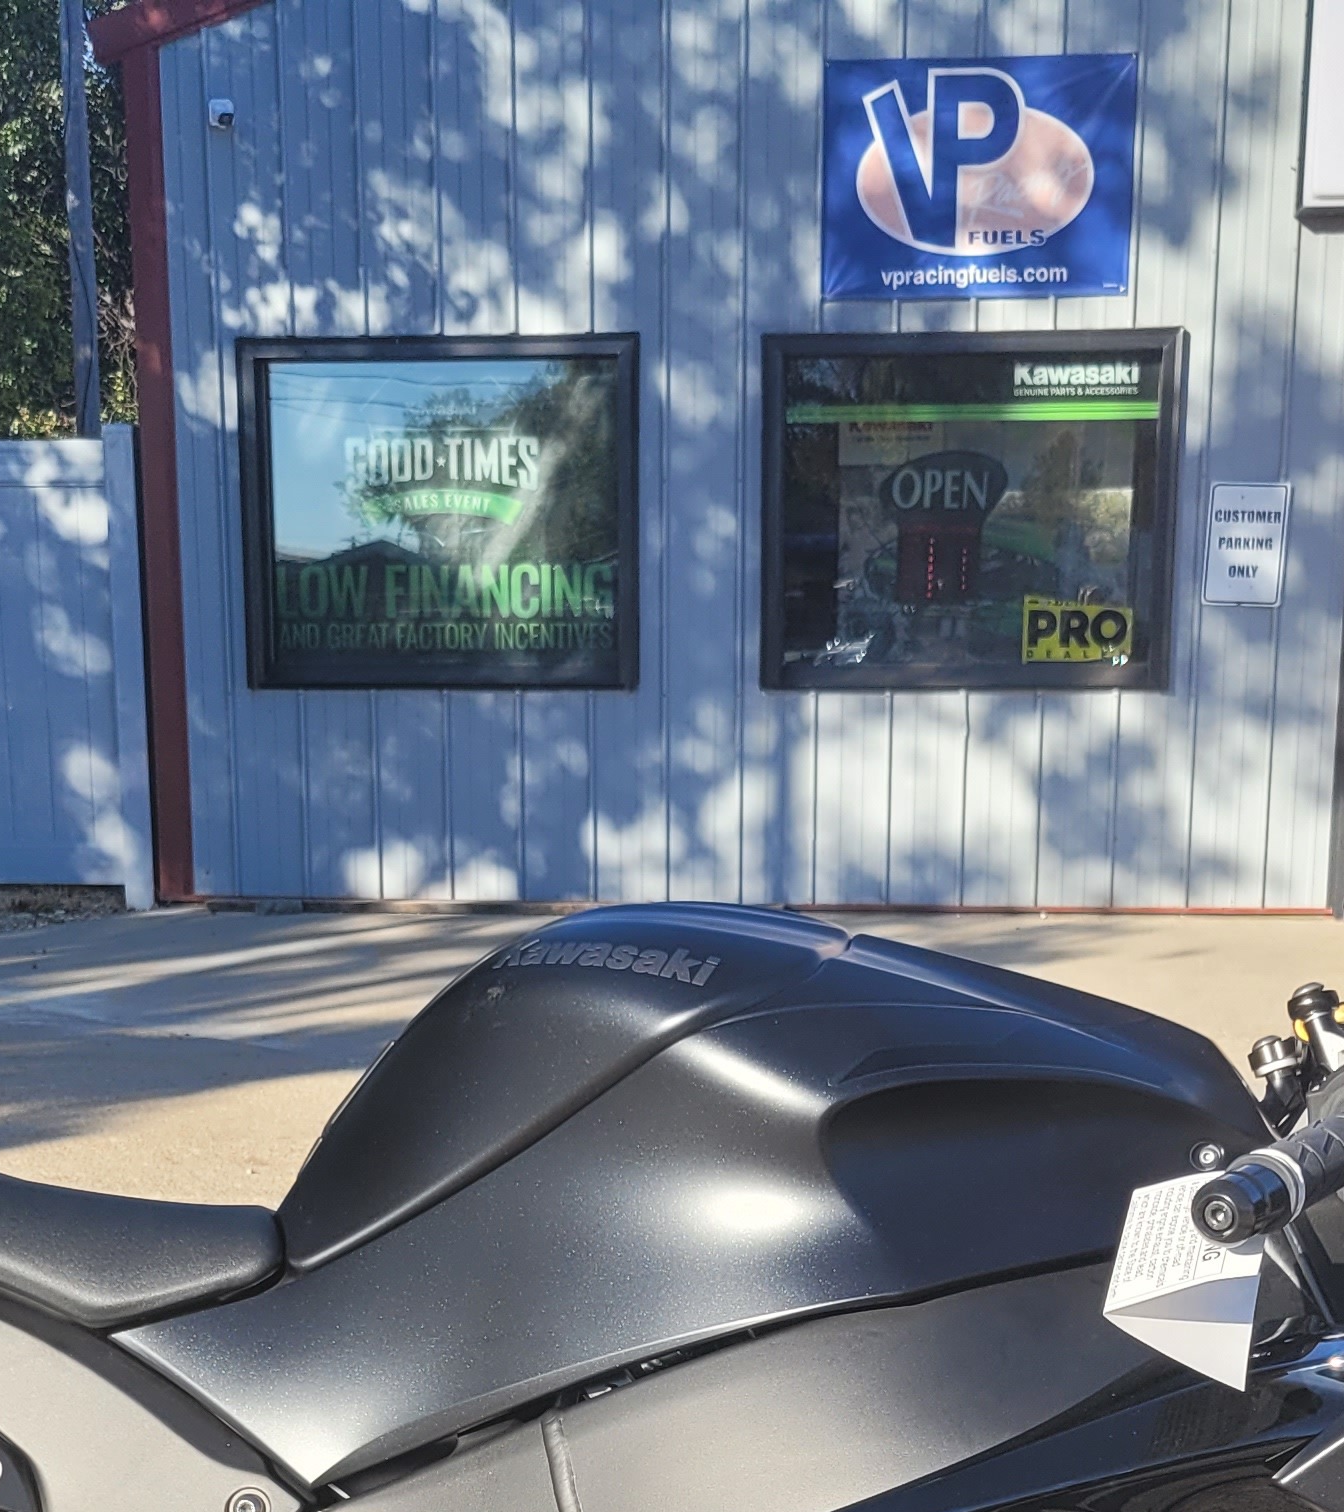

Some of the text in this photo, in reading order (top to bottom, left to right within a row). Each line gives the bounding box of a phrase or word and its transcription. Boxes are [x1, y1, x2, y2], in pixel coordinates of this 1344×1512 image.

[862, 67, 1026, 250] VP
[968, 230, 1045, 246] FUELS
[881, 266, 1068, 291] vpracingfuels.com
[1014, 362, 1139, 386] Kawasaki
[1014, 386, 1139, 397] GENUINE PARTS & ACCESSORIES
[345, 437, 539, 491] GOOD TIMES
[891, 470, 989, 510] OPEN
[445, 495, 492, 511] EVENT
[1214, 509, 1281, 524] CUSTOMER
[1218, 537, 1273, 551] PARKING
[1228, 565, 1258, 578] ONLY
[276, 563, 615, 620] LOW FINANCING
[279, 622, 614, 650] AND GREAT FACTORY INCENTIVES
[1027, 609, 1128, 649] PRO
[492, 939, 722, 987] Kawasaki
